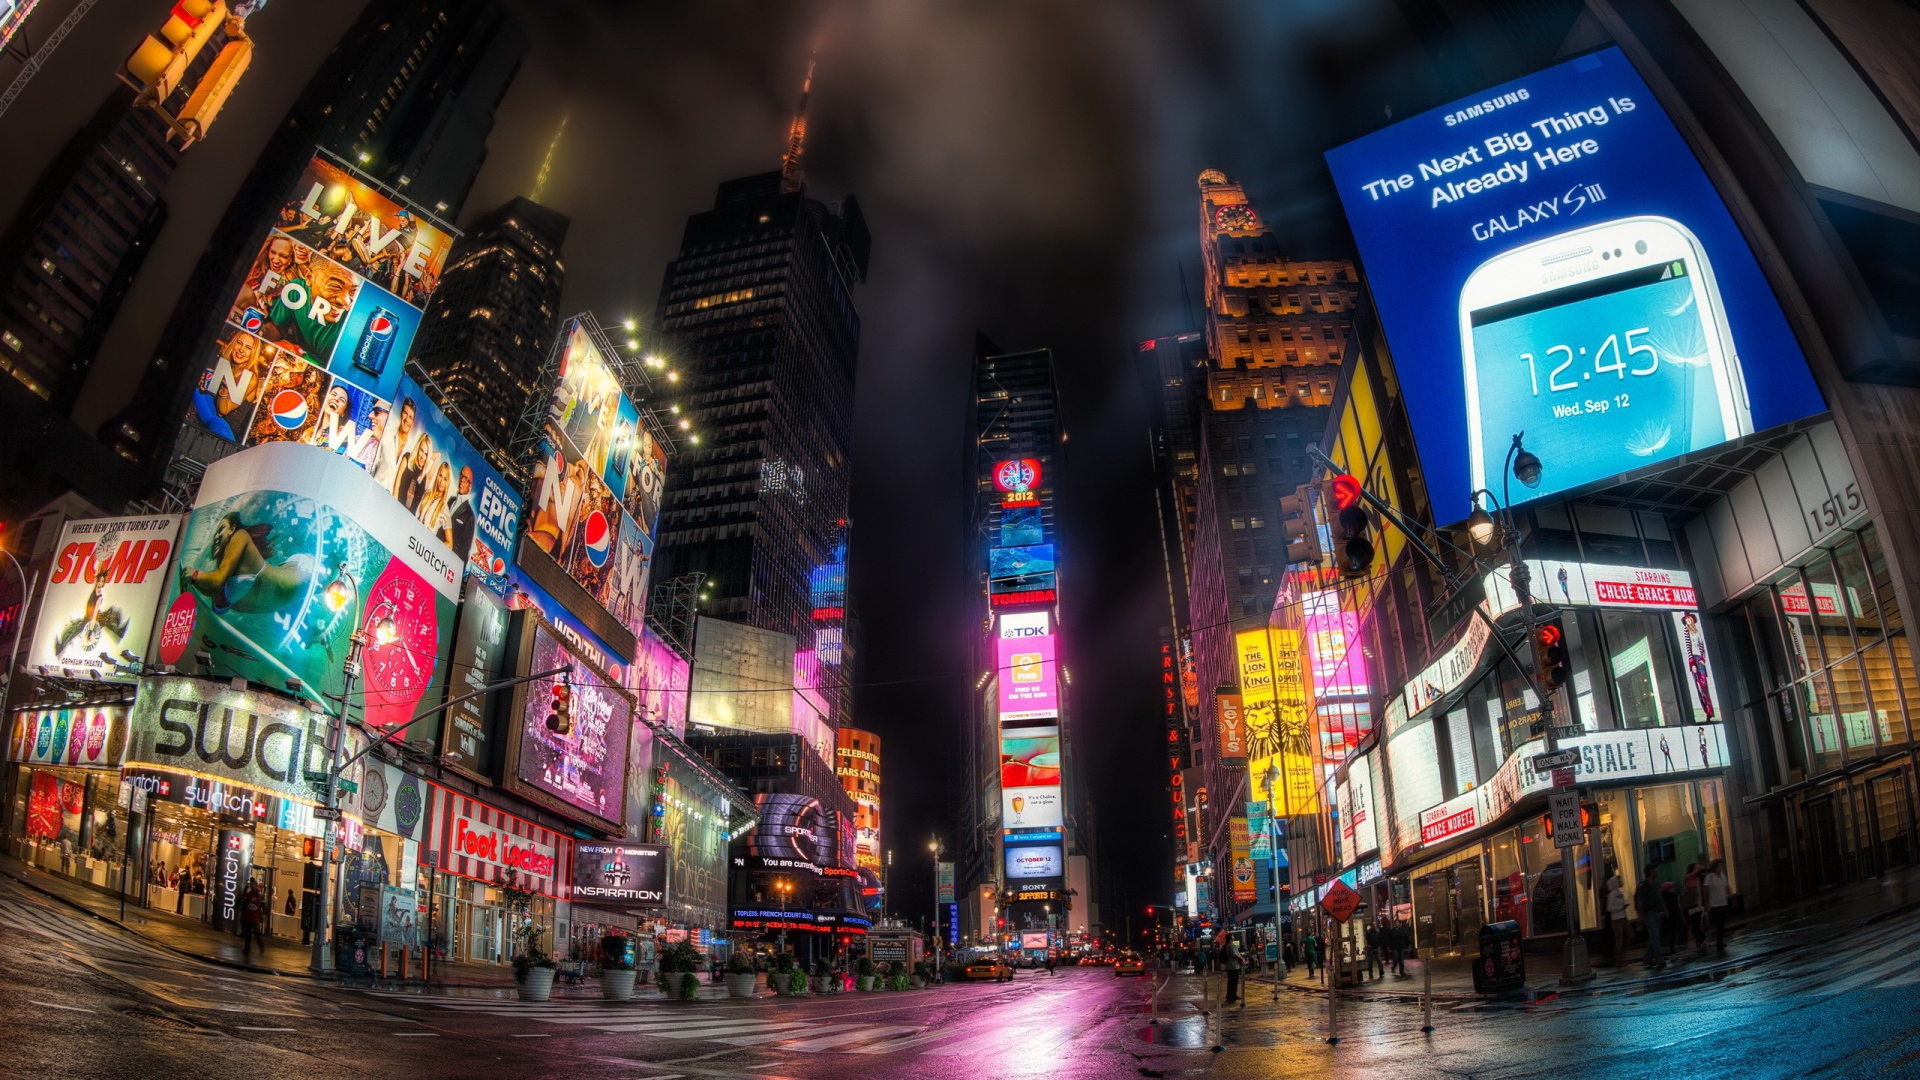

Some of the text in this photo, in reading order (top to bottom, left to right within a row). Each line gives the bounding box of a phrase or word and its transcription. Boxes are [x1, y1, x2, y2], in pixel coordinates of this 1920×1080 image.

[1444, 88, 1530, 126] SAMSUNG
[1362, 97, 1636, 201] The Next Big Thing Is
[1431, 139, 1600, 208] Already Here
[1472, 198, 1560, 242] GALAXY
[300, 181, 432, 280] LIVE
[1541, 260, 1600, 284] SAMSUNG
[258, 270, 333, 327] FOR
[1520, 327, 1660, 396] 12:45
[1552, 393, 1631, 418] Wed. Sep 12
[485, 476, 520, 514] CATCH EVERY
[1008, 491, 1034, 502] 2012
[1001, 499, 1041, 509] TOSHIBA
[1811, 483, 1860, 533] 1515
[479, 485, 518, 541] EPIC
[71, 519, 171, 535] WHERE NEW YORK TURNS IT UP
[476, 512, 513, 553] MOMENT
[51, 540, 171, 583] STOMP
[407, 534, 448, 578] swatch
[1634, 570, 1671, 584] STARRING
[990, 589, 1056, 605] TOSHIBA
[1598, 582, 1635, 600] CHLOË
[1637, 587, 1671, 602] GRACE
[165, 608, 195, 627] PUSH
[1443, 596, 1466, 625] 7 AV
[1014, 626, 1045, 637] TDK
[161, 633, 189, 648] OF FUN
[84, 658, 103, 668] THEATRE
[1245, 653, 1262, 661] THE
[1018, 672, 1037, 680] FIND
[1243, 661, 1266, 675] LION
[1243, 675, 1271, 690] KING
[1568, 726, 1579, 737] 45
[789, 734, 798, 773] 1500
[837, 747, 880, 764] CELEBRATING
[1540, 753, 1574, 767] ONE WAY
[184, 784, 254, 814] swatch
[1555, 797, 1574, 808] WAIT
[1426, 806, 1448, 823] STARRING
[1559, 808, 1574, 819] FOR
[1426, 810, 1475, 840] GRACE MORETZ
[1557, 820, 1579, 831] WALK
[1557, 833, 1580, 843] SIGNAL
[456, 818, 554, 877] Foot Locker
[594, 846, 613, 854] FROM
[624, 849, 658, 857] MONSTER
[763, 858, 779, 867] You
[223, 848, 240, 920] swatch
[573, 885, 663, 900] INSPIRATION
[1018, 891, 1048, 901] SUPPORTS
[1332, 905, 1352, 913] AHEAD
